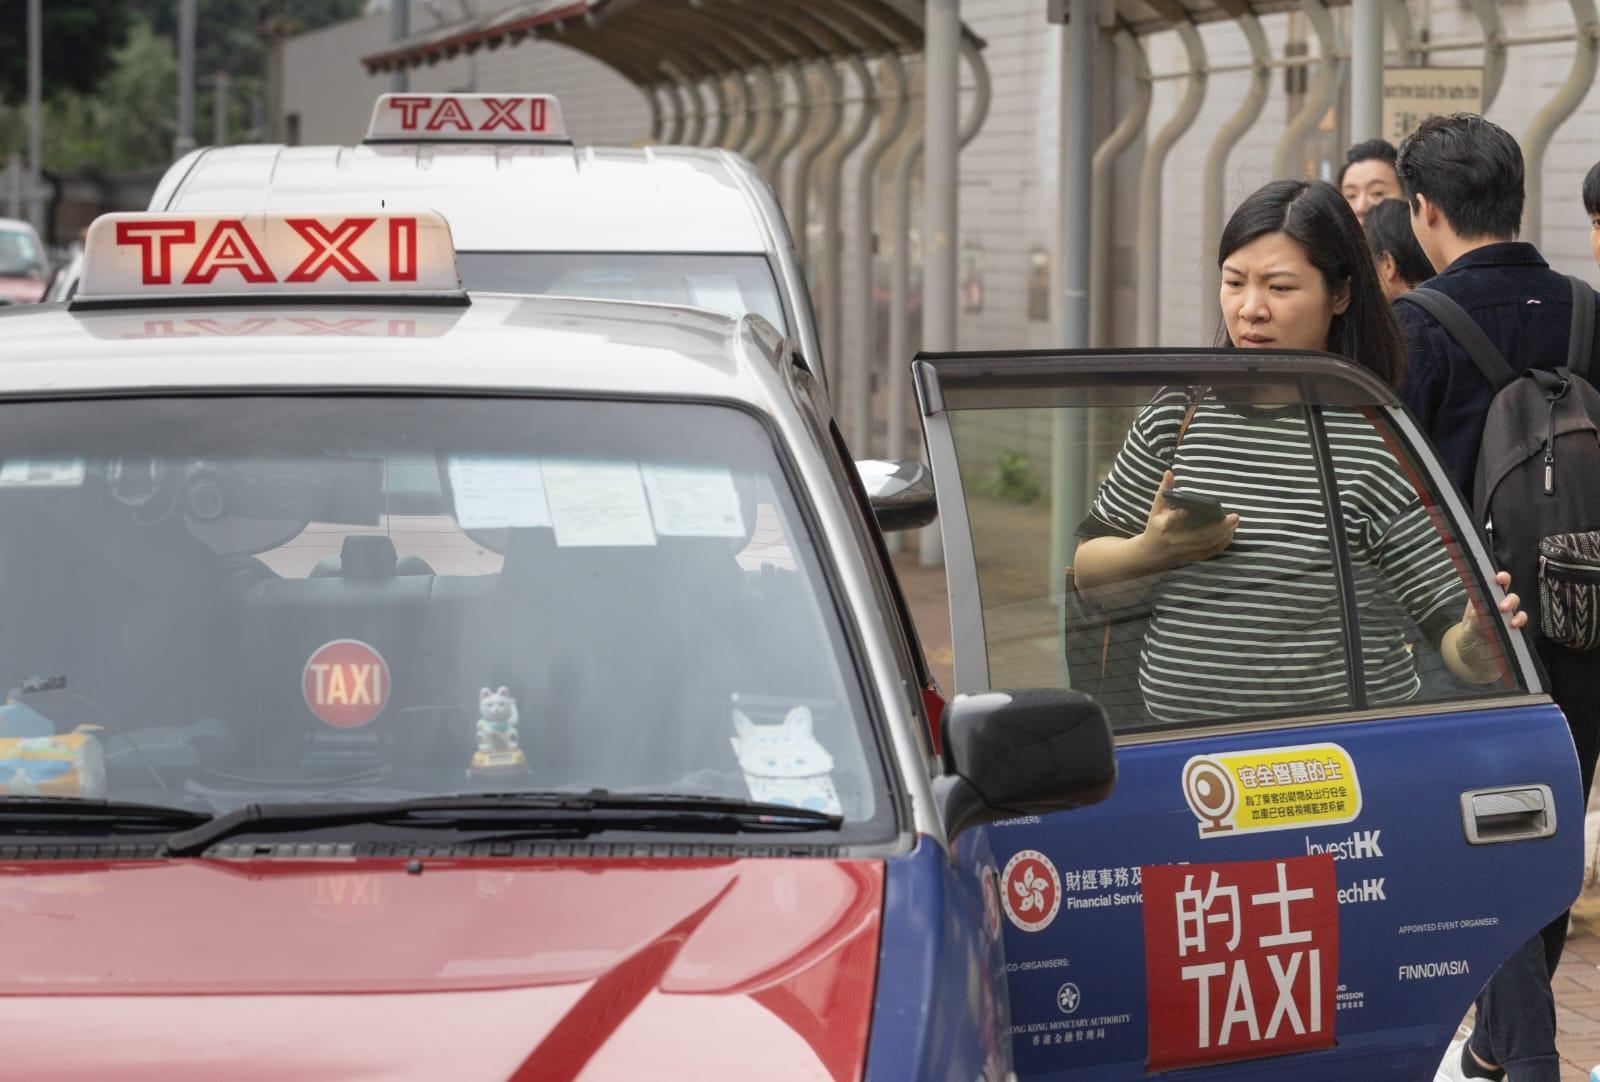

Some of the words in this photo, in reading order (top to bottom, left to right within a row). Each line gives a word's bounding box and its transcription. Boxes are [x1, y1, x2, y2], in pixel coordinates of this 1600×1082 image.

[390, 97, 546, 131] TAXI
[116, 217, 418, 285] TAXI
[310, 664, 382, 705] TAXI
[1237, 757, 1343, 788] 安全智慧的士
[1305, 829, 1384, 861] InvestHK
[1067, 894, 1112, 909] Financial
[1174, 862, 1314, 957] 的士
[1398, 922, 1437, 935] APPOINTED
[1437, 920, 1460, 931] EVENT
[1006, 958, 1070, 972] CO-ORGANISERS:
[1398, 960, 1470, 981] FINNOVASIA
[1181, 948, 1322, 1048] TAXI
[1336, 984, 1347, 992] ND
[1009, 1024, 1027, 1034] ONG
[1027, 1022, 1048, 1033] KONG
[1049, 1018, 1089, 1031] MONETARY
[1089, 1014, 1132, 1026] AUTHORITY
